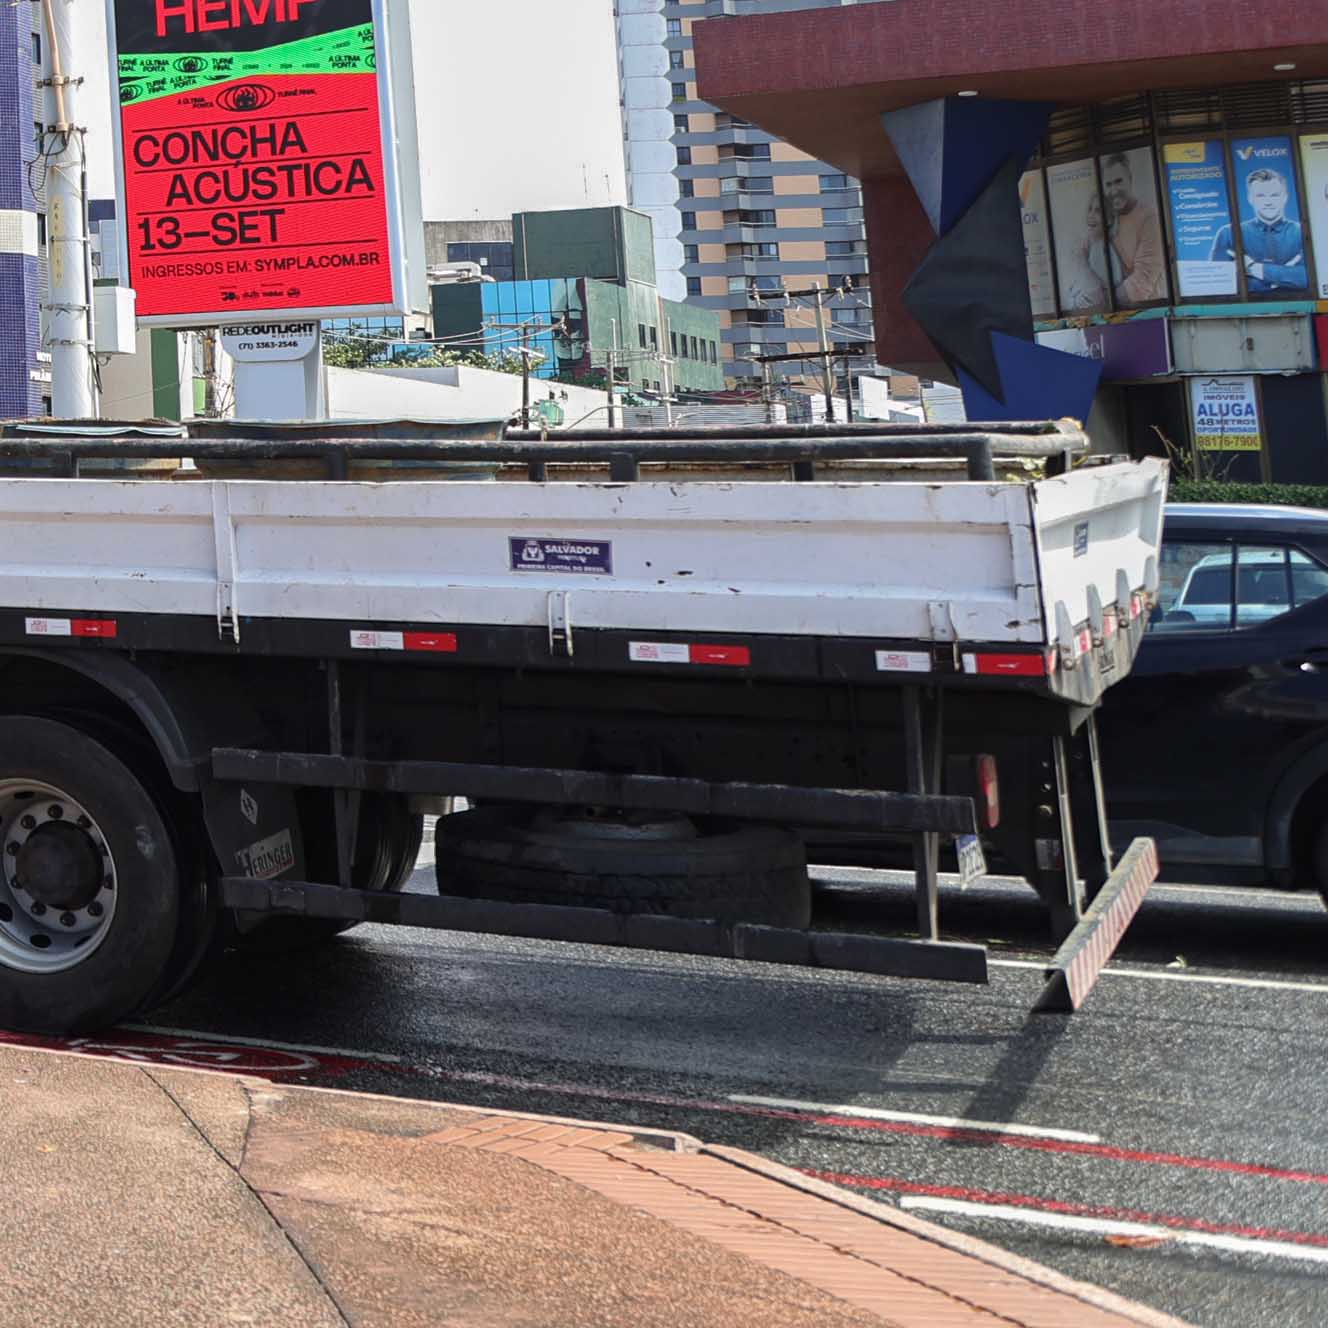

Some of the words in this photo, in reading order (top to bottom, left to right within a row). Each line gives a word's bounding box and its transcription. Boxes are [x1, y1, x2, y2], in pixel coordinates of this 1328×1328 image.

[133, 122, 308, 168] CONCHA
[1254, 147, 1288, 158] VELOX
[165, 158, 375, 207] ACÚSTICA
[142, 261, 224, 279] INGRESSOS
[226, 260, 252, 274] EM:
[255, 252, 381, 273] SYMPLA.COM.BR
[1197, 403, 1255, 417] ALUGA
[1197, 418, 1215, 426] 48
[544, 544, 600, 555] SALVADOR
